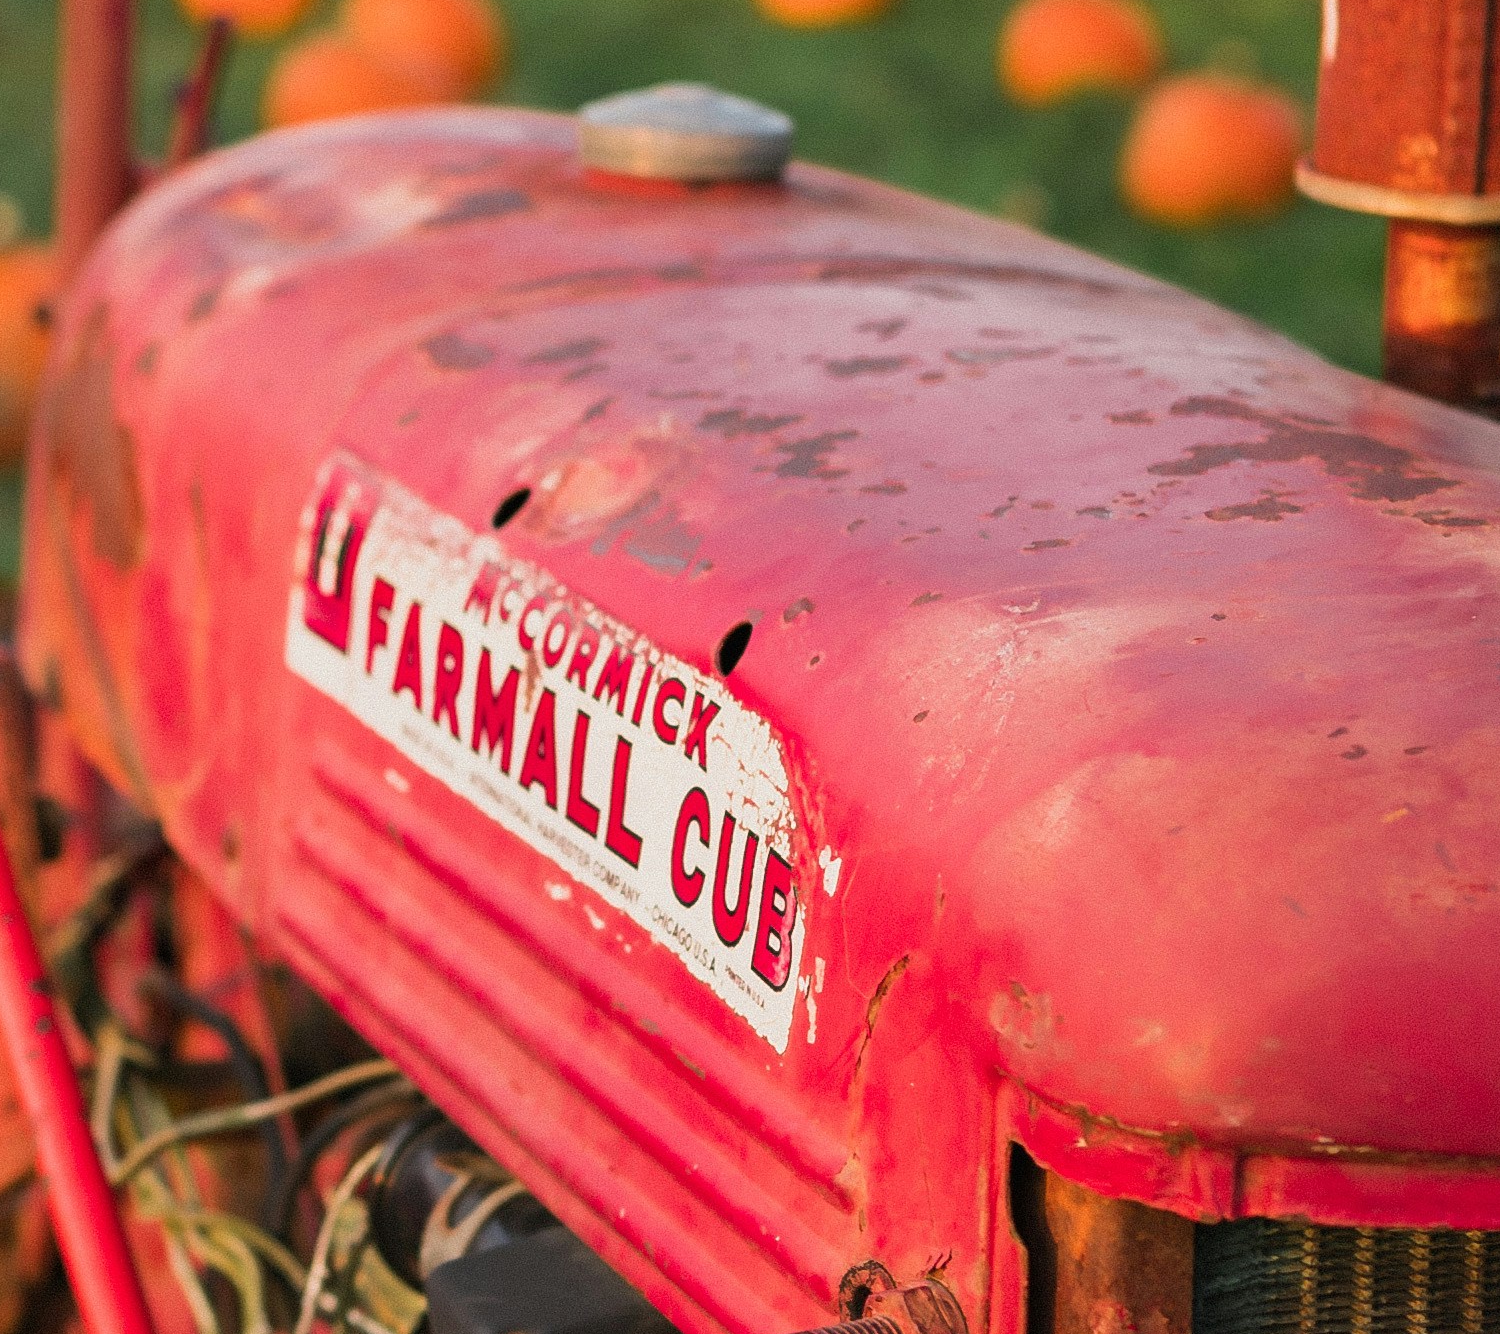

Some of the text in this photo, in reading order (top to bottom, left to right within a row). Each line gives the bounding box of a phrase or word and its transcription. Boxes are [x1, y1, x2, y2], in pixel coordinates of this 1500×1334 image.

[365, 575, 798, 993] FARMALL CUB
[592, 860, 640, 903] COMPANY
[651, 904, 693, 952] CHICAGO
